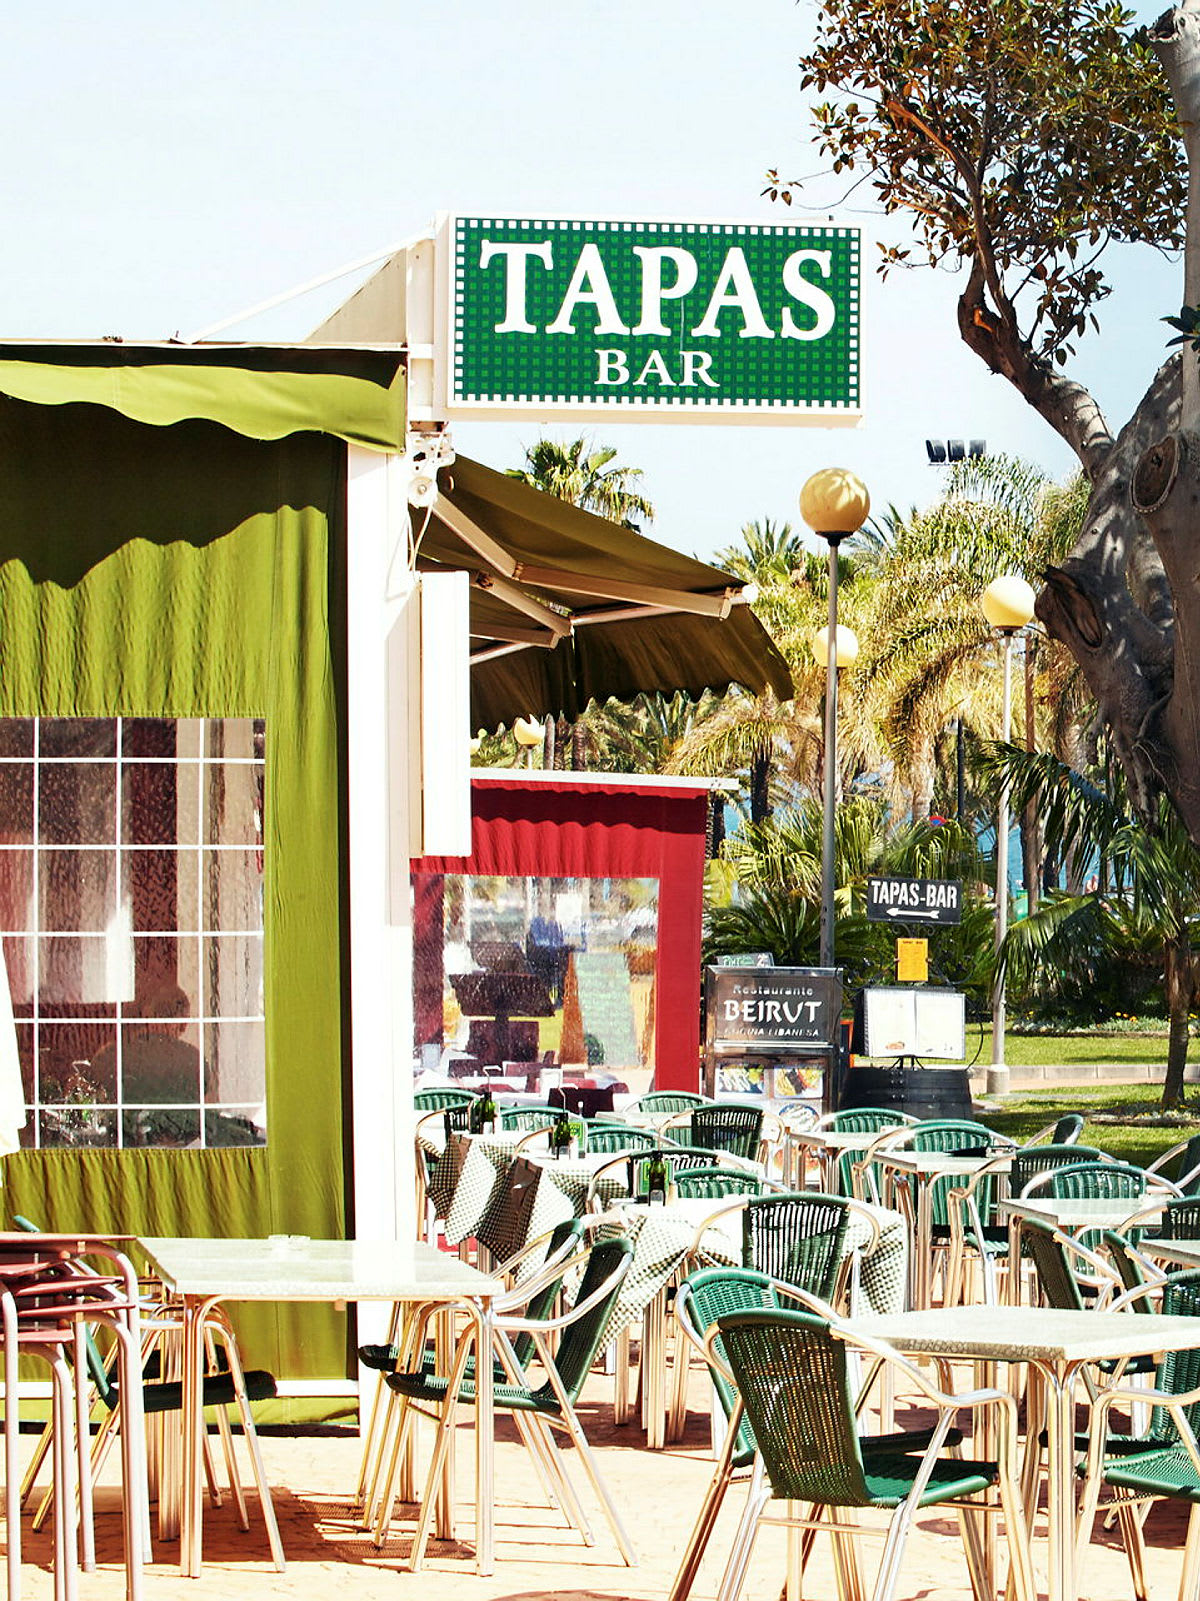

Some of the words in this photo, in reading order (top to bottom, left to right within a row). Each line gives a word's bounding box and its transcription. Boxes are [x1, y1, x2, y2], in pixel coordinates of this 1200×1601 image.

[479, 239, 836, 341] TAPAS
[594, 349, 720, 388] BAR
[871, 880, 957, 908] TAPAS-BAR
[733, 984, 813, 996] Restaurante
[724, 1000, 822, 1023] BEIRUT
